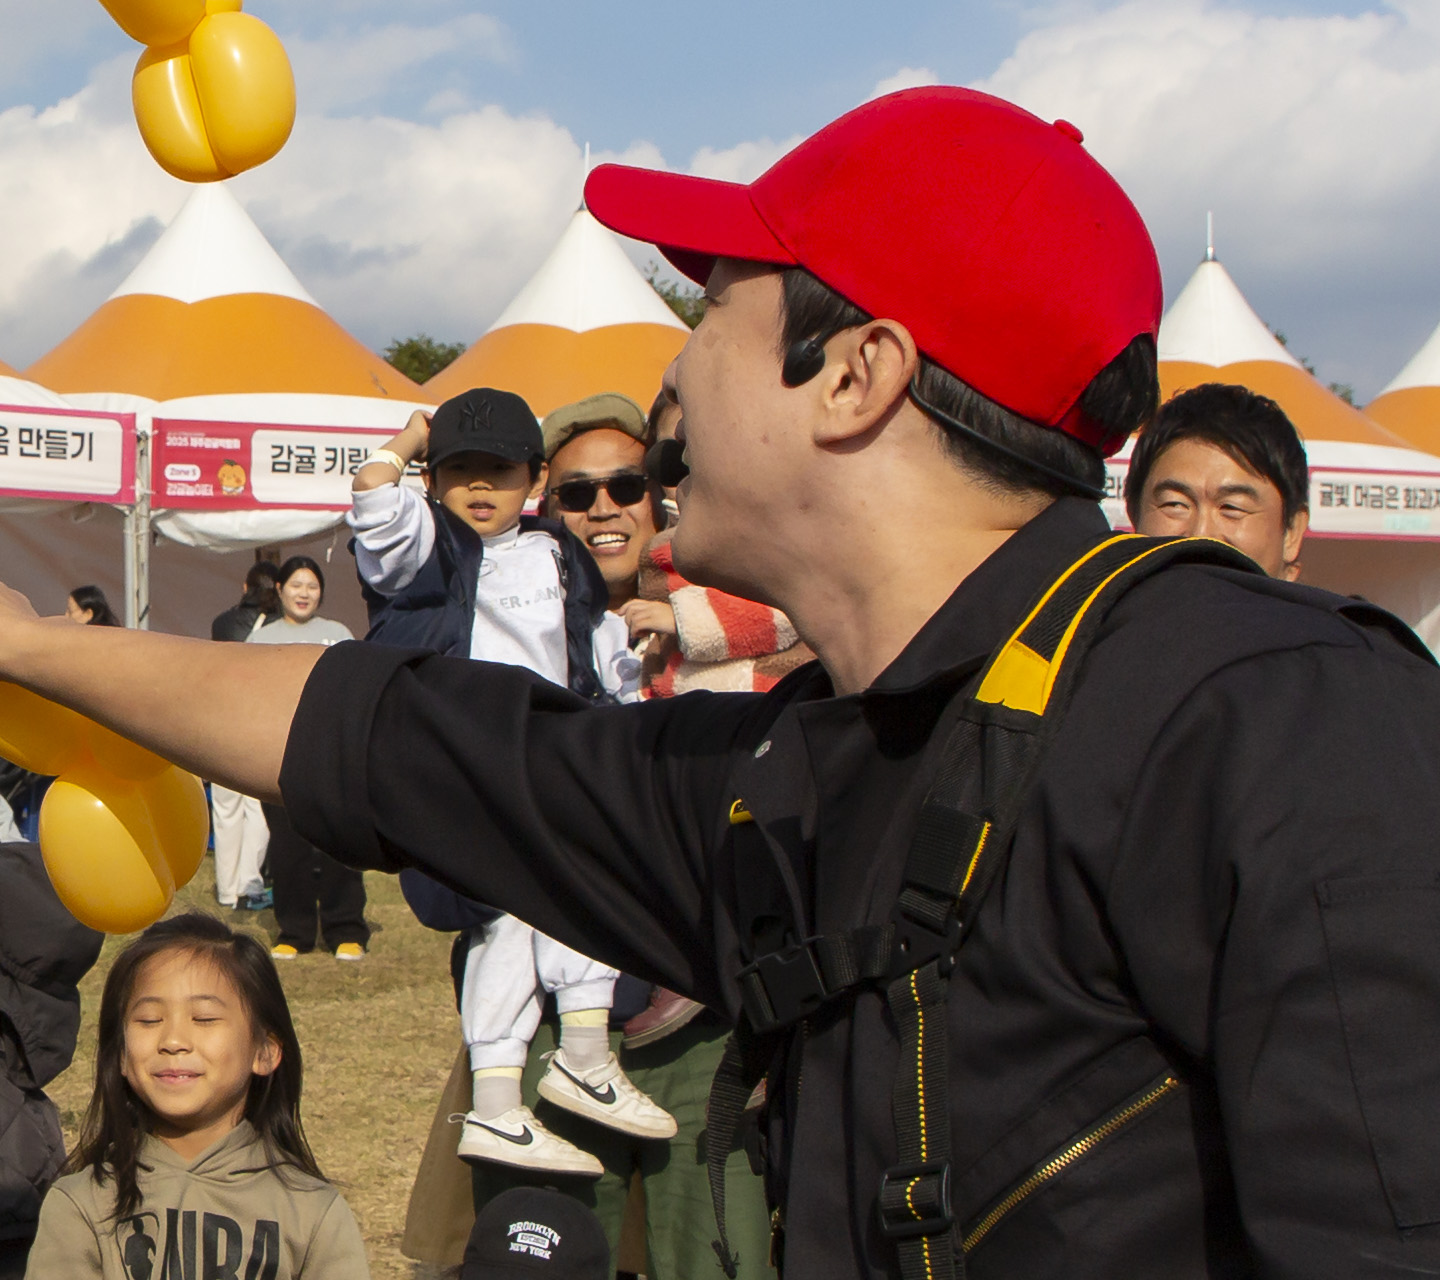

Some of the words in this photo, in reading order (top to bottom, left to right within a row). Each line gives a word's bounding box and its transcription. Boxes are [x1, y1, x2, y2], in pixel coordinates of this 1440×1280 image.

[458, 399, 494, 432] NY
[18, 427, 94, 462] 만들기
[271, 444, 316, 474] 감귤
[1355, 484, 1400, 510] 머금은
[507, 1221, 562, 1247] BROOKLYN
[509, 1241, 528, 1253] NEW
[529, 1245, 552, 1260] YORK
